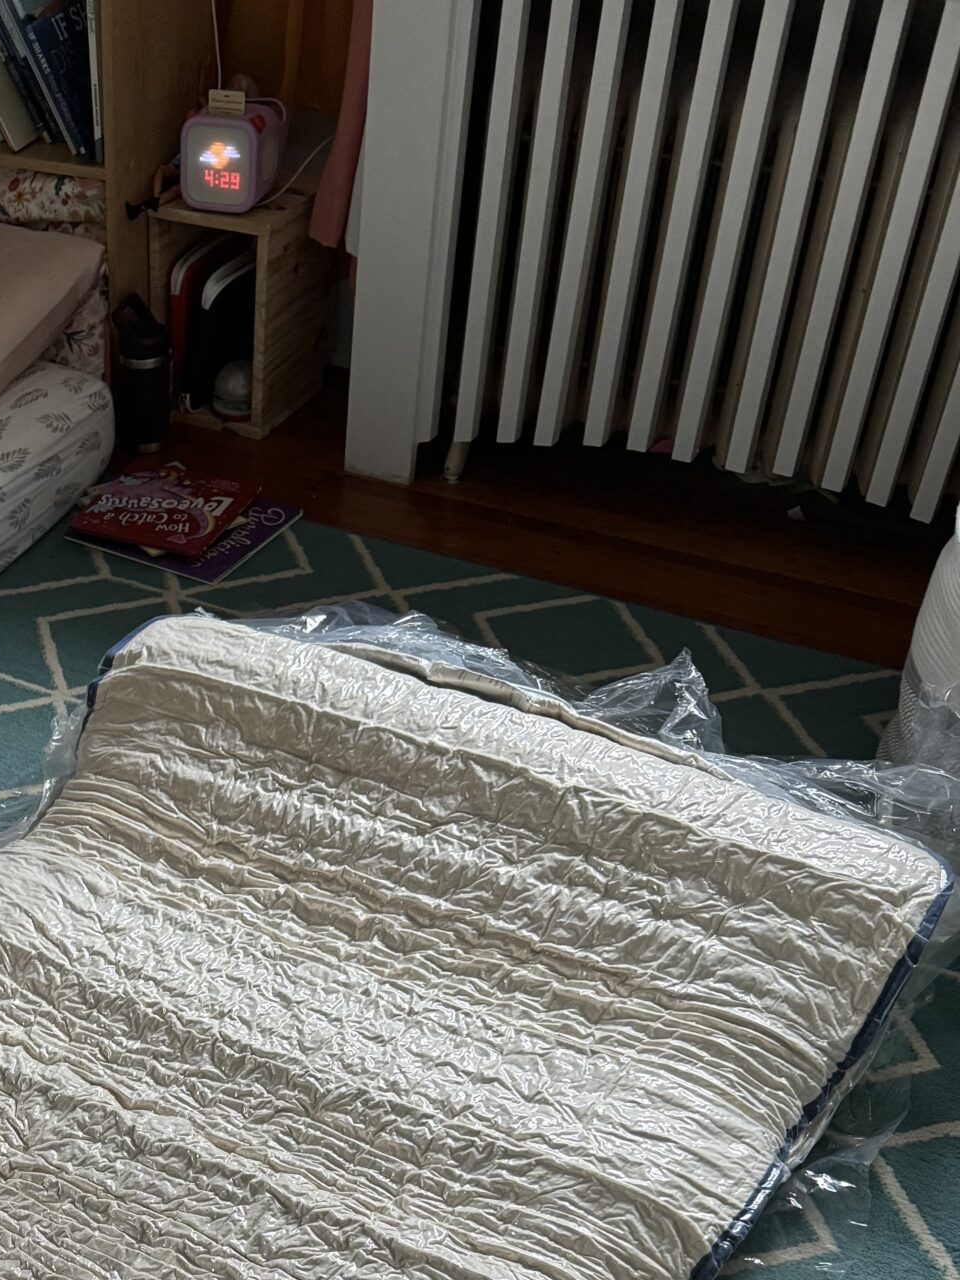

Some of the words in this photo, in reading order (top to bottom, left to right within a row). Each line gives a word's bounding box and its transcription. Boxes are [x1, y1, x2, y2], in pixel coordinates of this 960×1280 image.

[32, 42, 51, 75] SHARKS
[204, 169, 241, 191] 4:29
[99, 493, 235, 517] Loveosaurus
[119, 512, 167, 526] Catch
[172, 513, 188, 522] to
[155, 522, 190, 534] How
